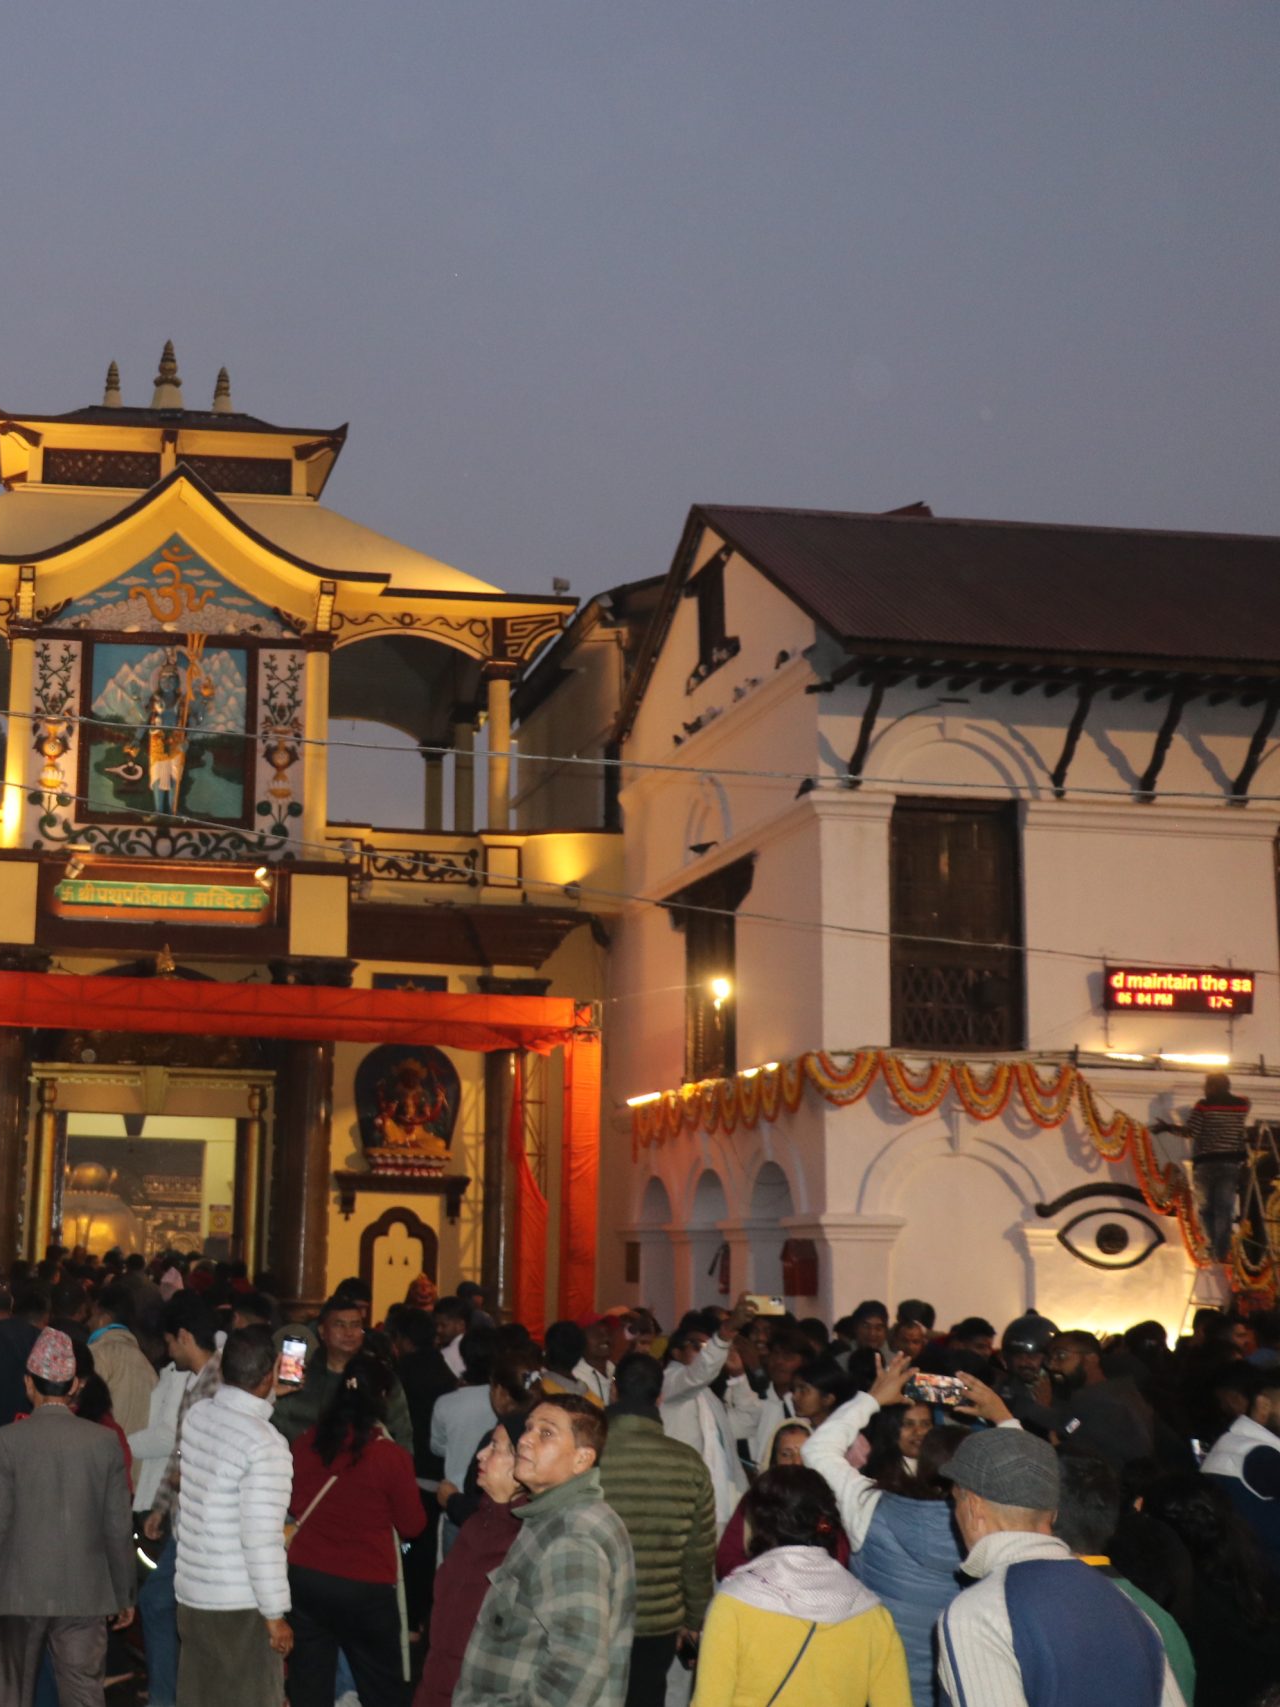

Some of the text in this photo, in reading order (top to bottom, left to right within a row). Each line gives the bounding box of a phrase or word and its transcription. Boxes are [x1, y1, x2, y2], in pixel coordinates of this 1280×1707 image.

[1127, 973, 1197, 990] maintain
[1200, 975, 1228, 992] the
[1230, 978, 1252, 992] sa
